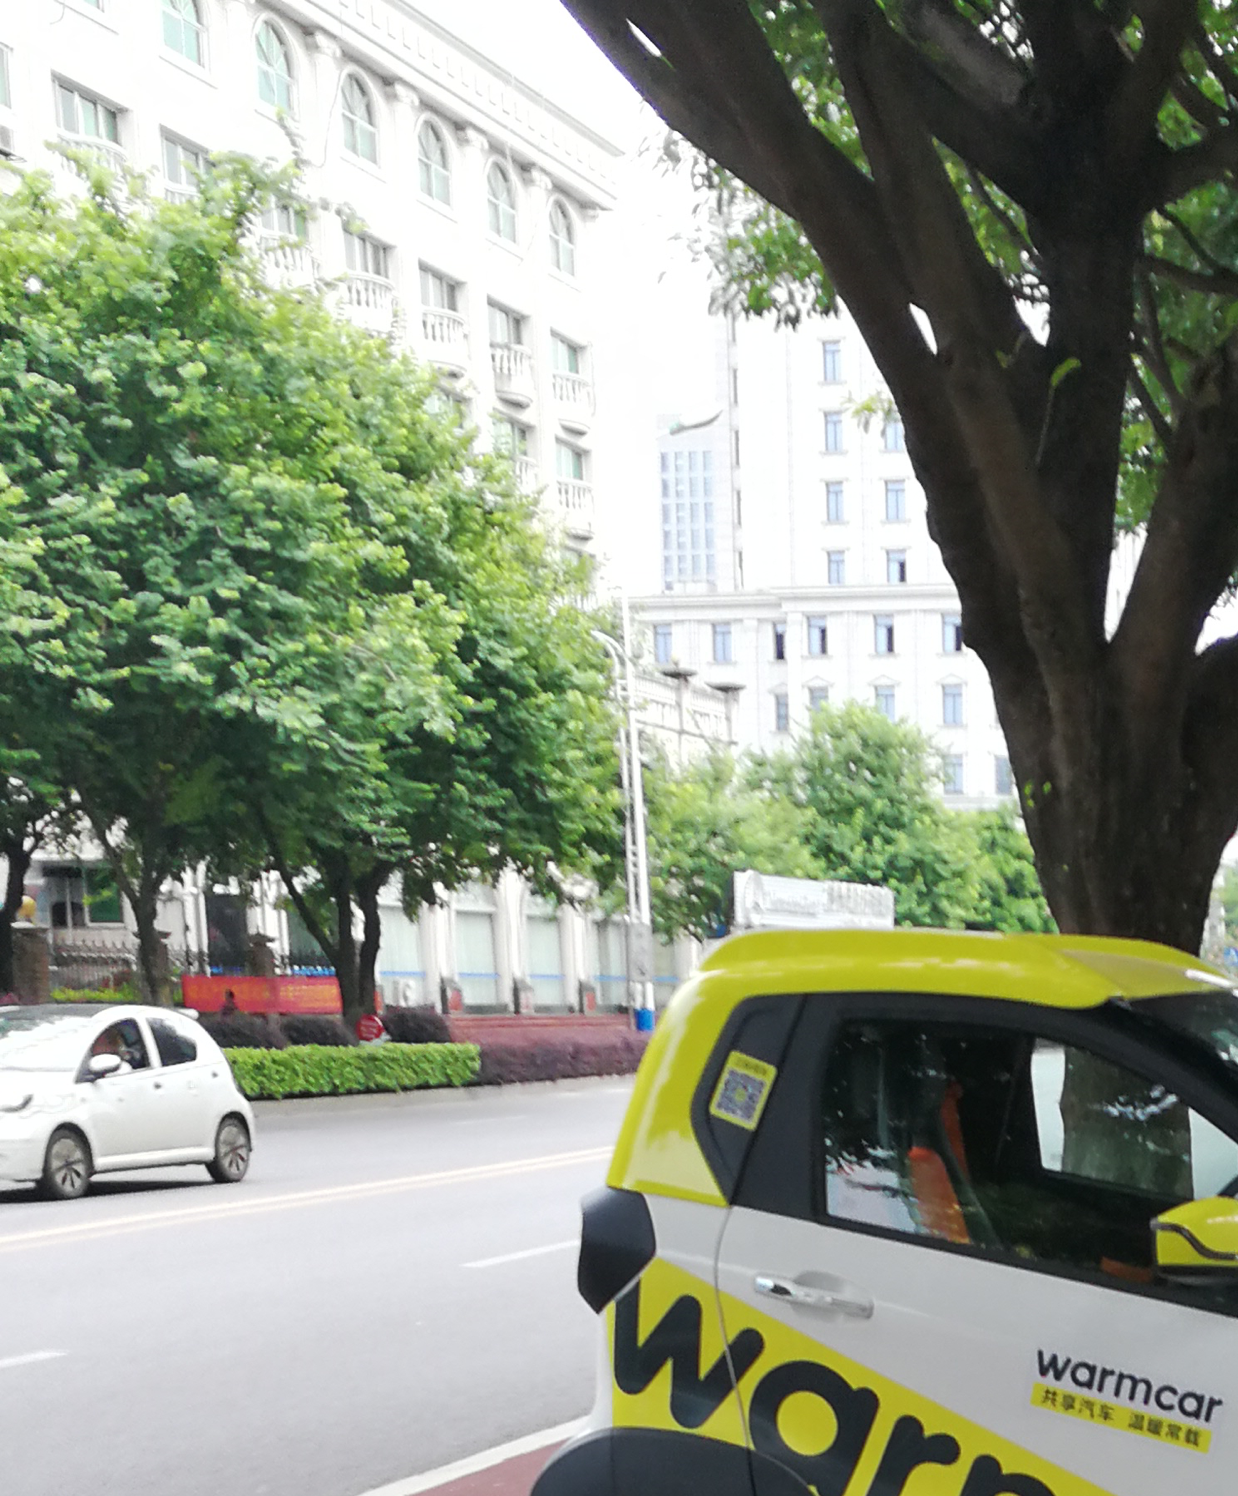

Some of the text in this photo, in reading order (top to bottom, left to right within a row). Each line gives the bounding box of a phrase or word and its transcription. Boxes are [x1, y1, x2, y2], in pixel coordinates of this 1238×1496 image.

[1036, 1347, 1224, 1424] warmcar
[1041, 1386, 1115, 1422] 共享汽车
